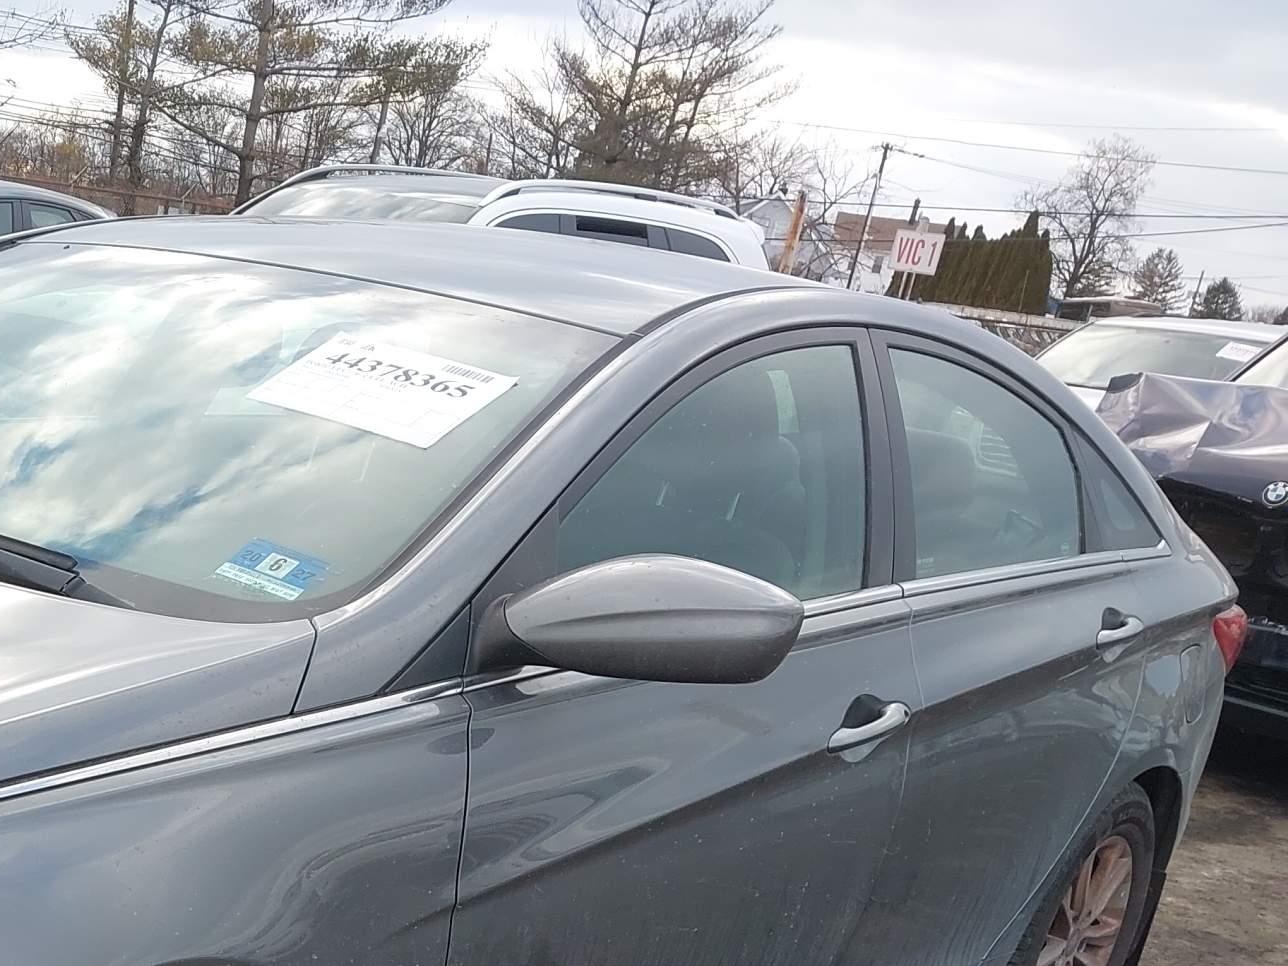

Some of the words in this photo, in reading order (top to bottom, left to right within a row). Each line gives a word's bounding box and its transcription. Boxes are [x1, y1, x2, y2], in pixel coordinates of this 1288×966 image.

[897, 236, 925, 266] VIC
[928, 241, 938, 267] 1
[325, 352, 476, 398] 44378365
[241, 550, 262, 562] 20
[268, 557, 288, 572] 6
